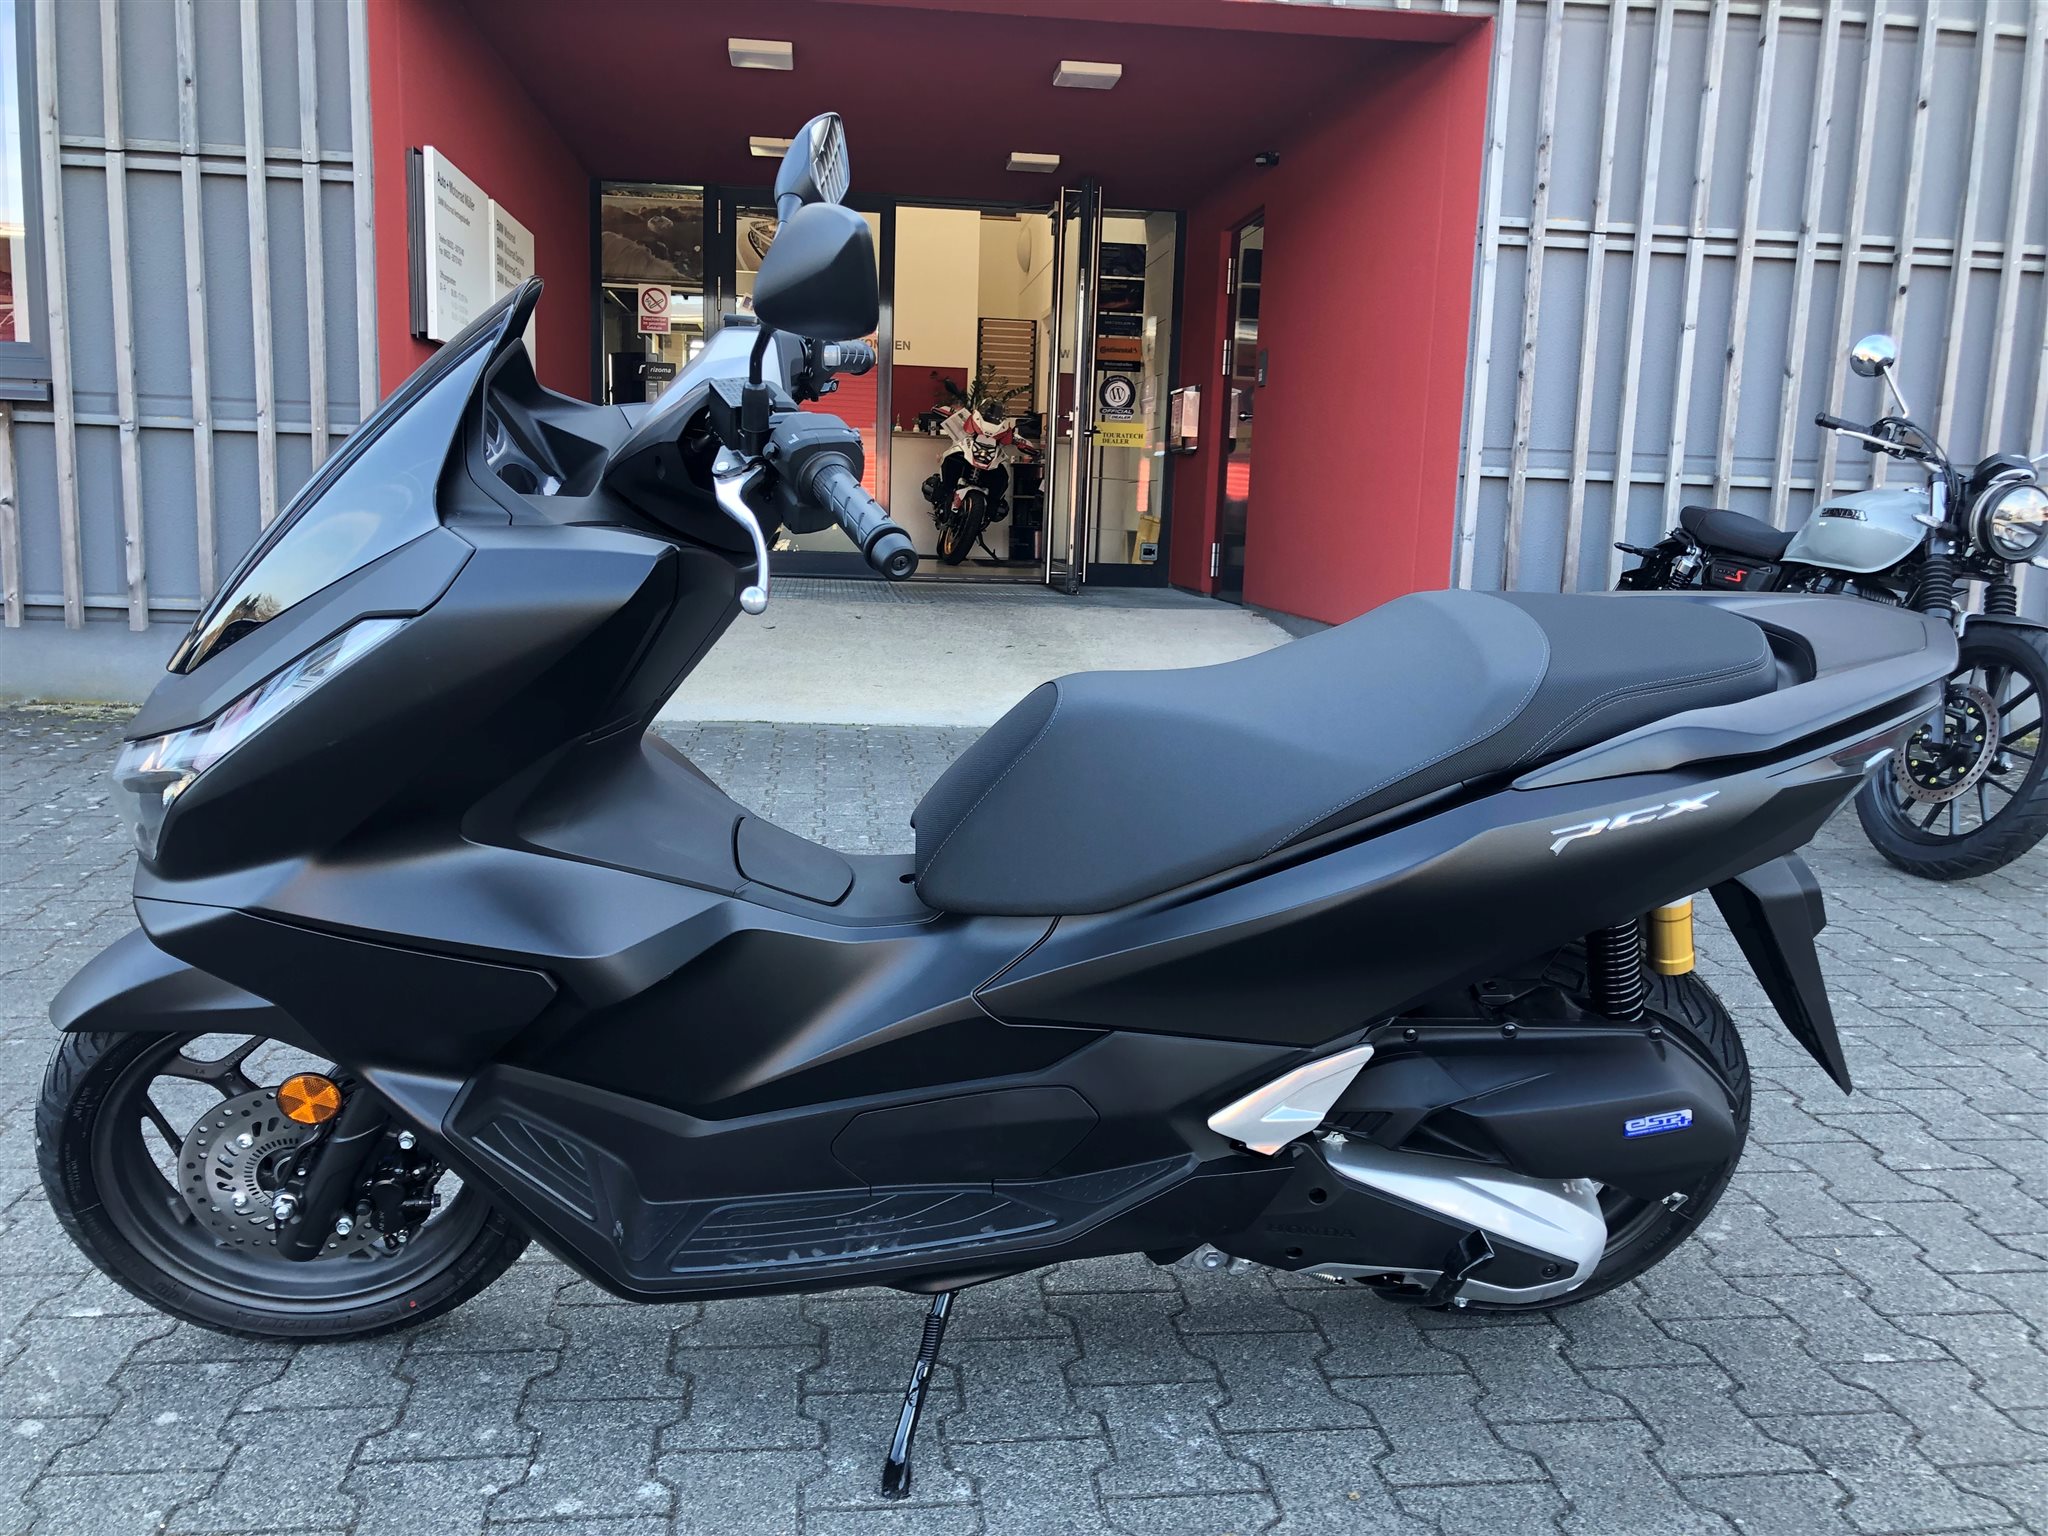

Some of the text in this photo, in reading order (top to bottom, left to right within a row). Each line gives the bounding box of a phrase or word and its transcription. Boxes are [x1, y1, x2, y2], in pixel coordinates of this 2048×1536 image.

[650, 366, 672, 374] rizoma
[1103, 432, 1144, 440] TOURATECH
[1266, 1223, 1357, 1240] HONDA
